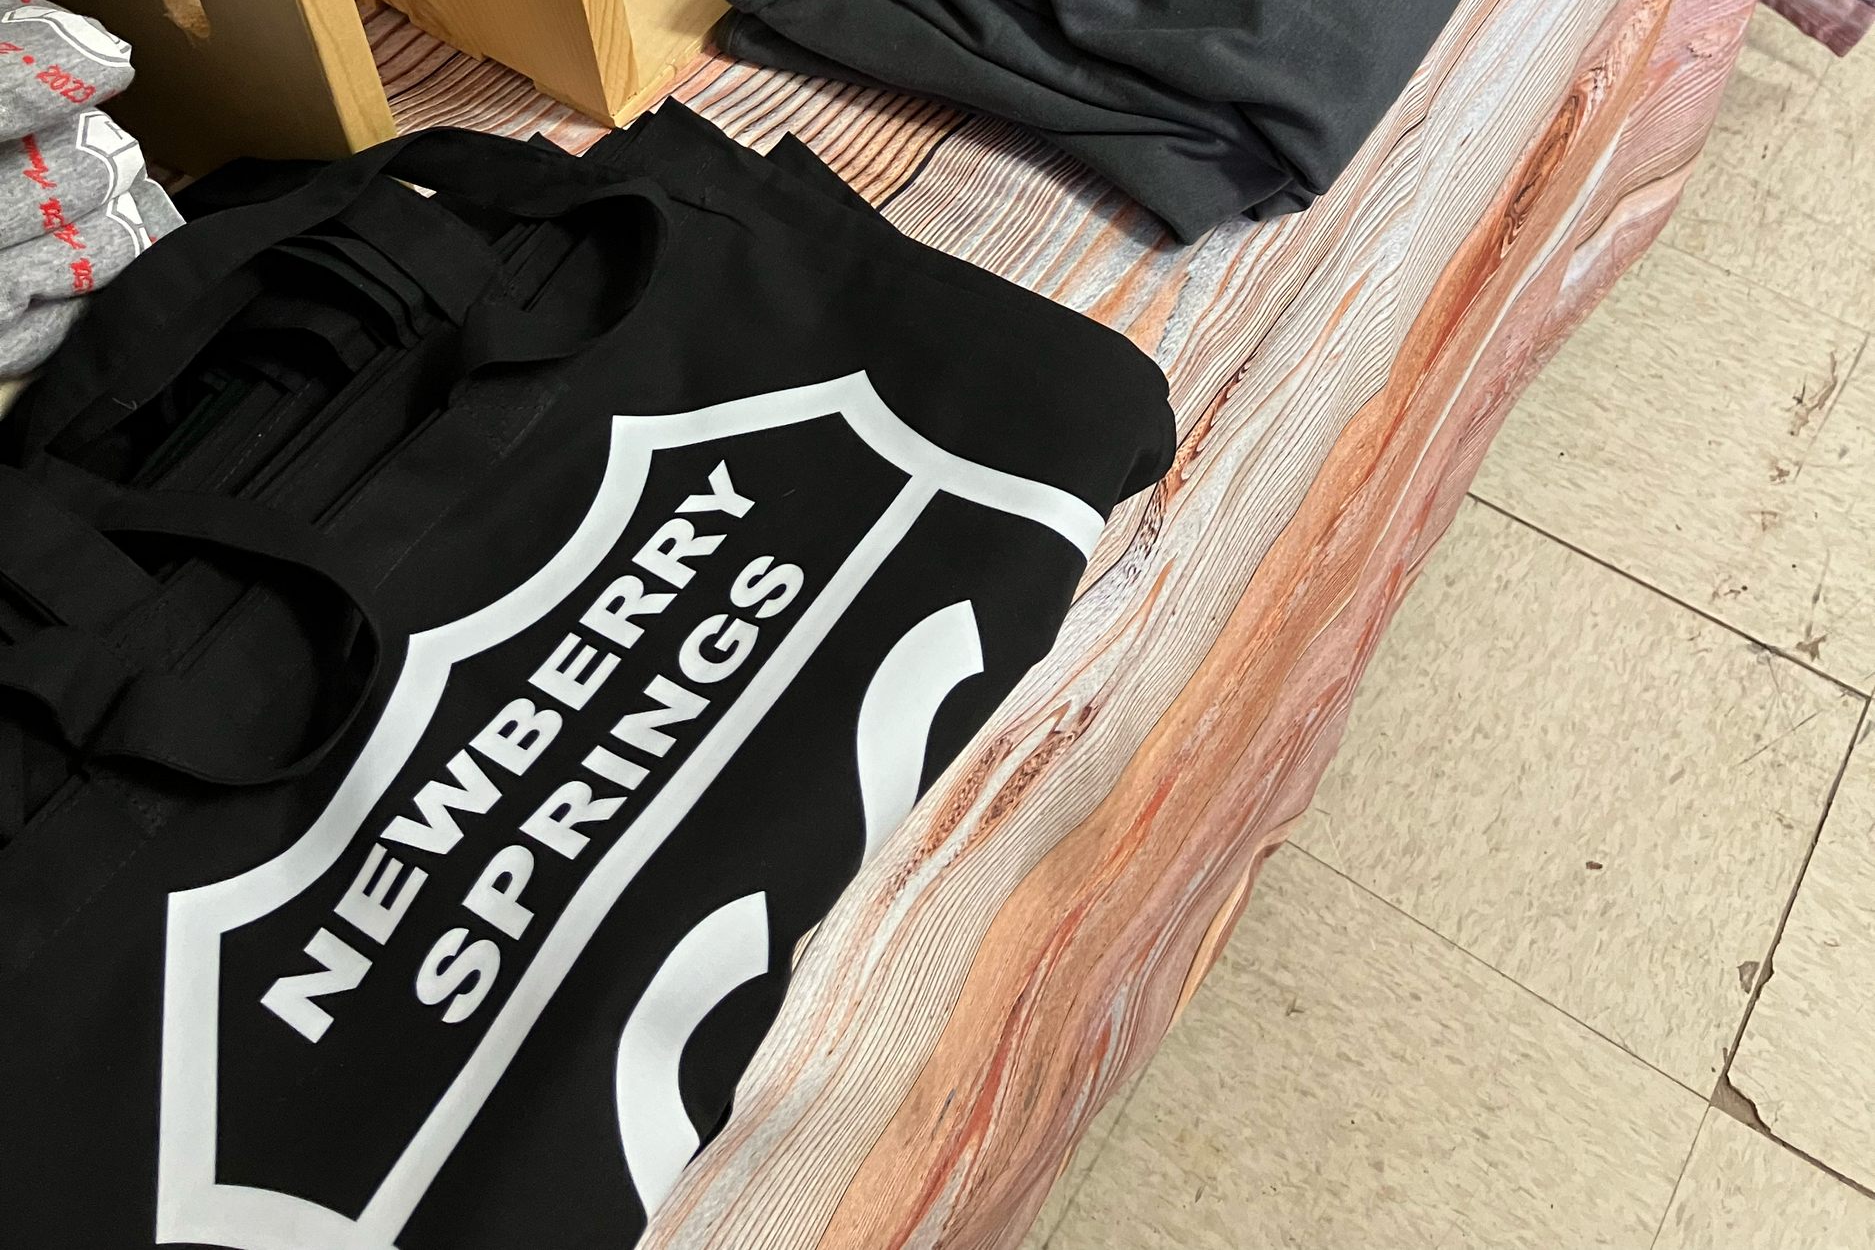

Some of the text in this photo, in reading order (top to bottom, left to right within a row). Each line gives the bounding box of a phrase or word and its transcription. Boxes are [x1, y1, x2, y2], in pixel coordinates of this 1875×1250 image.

[36, 64, 97, 104] 2023
[260, 459, 756, 1044] NEWBERRY
[415, 555, 805, 1025] SPRINGS
